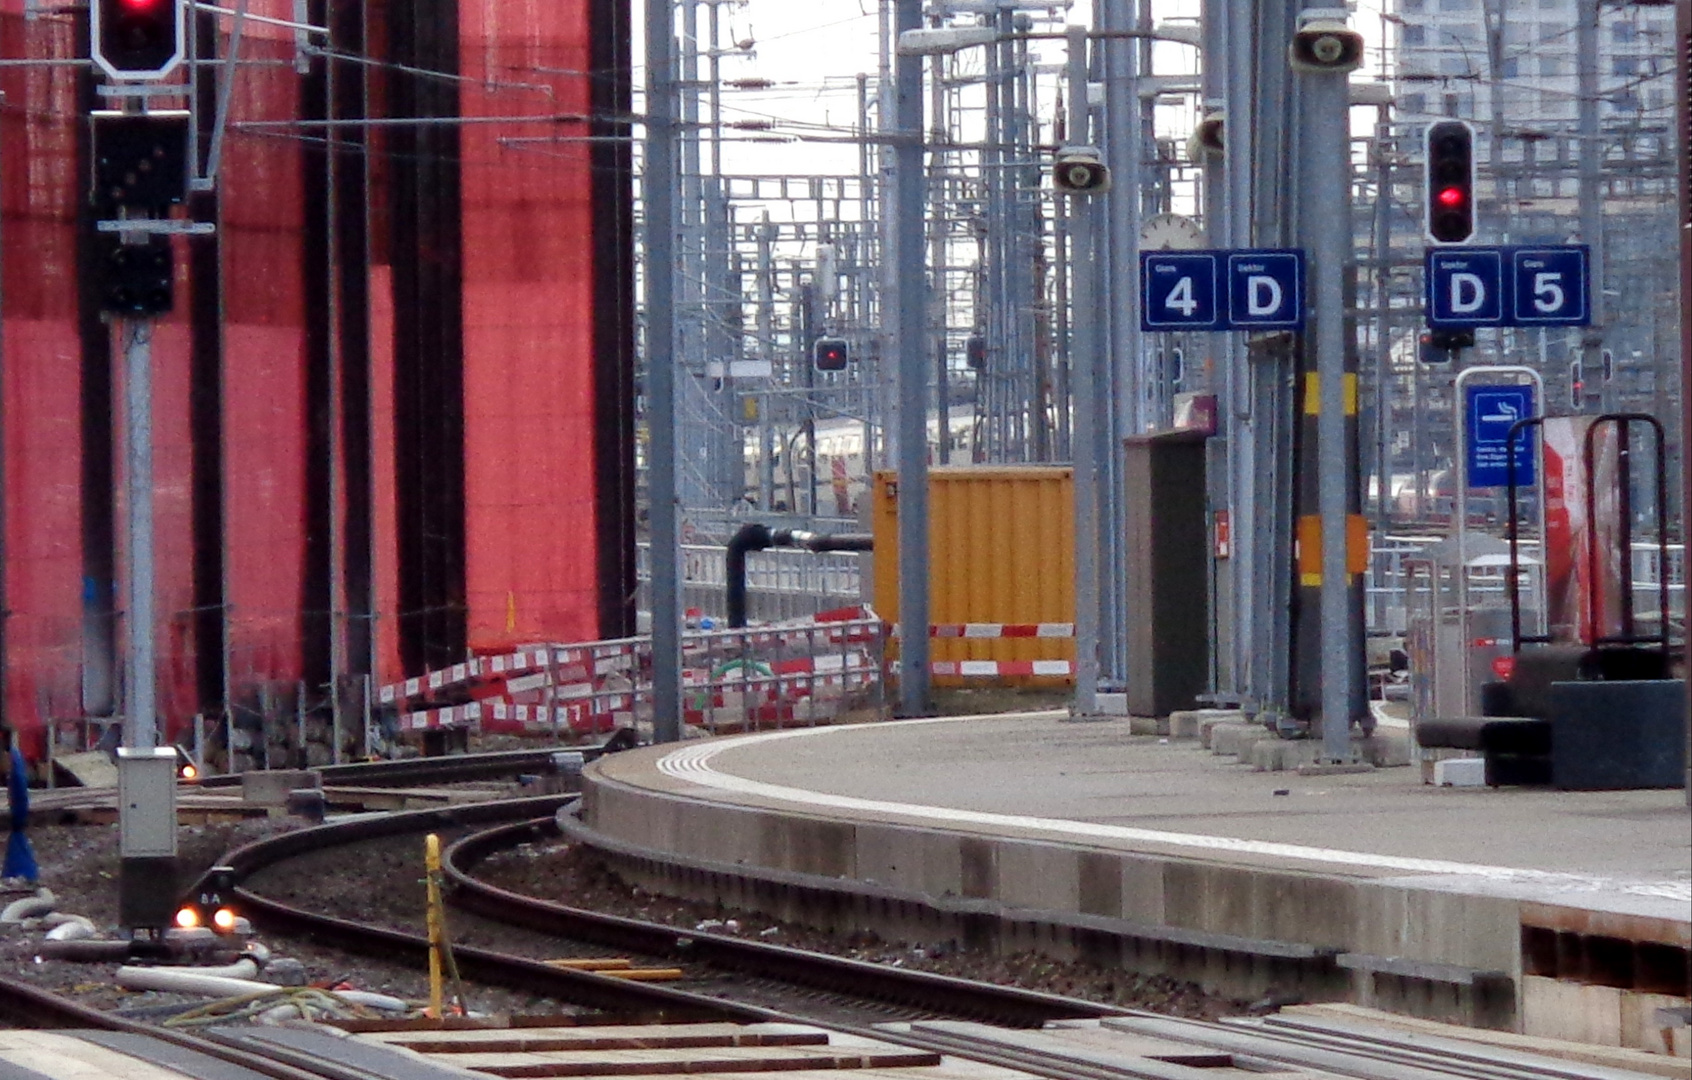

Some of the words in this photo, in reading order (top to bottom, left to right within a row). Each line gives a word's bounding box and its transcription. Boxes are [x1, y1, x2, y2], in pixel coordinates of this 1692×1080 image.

[1165, 276, 1197, 316] 4
[1249, 276, 1282, 315] D
[1452, 274, 1484, 312] D
[1535, 273, 1563, 311] 5
